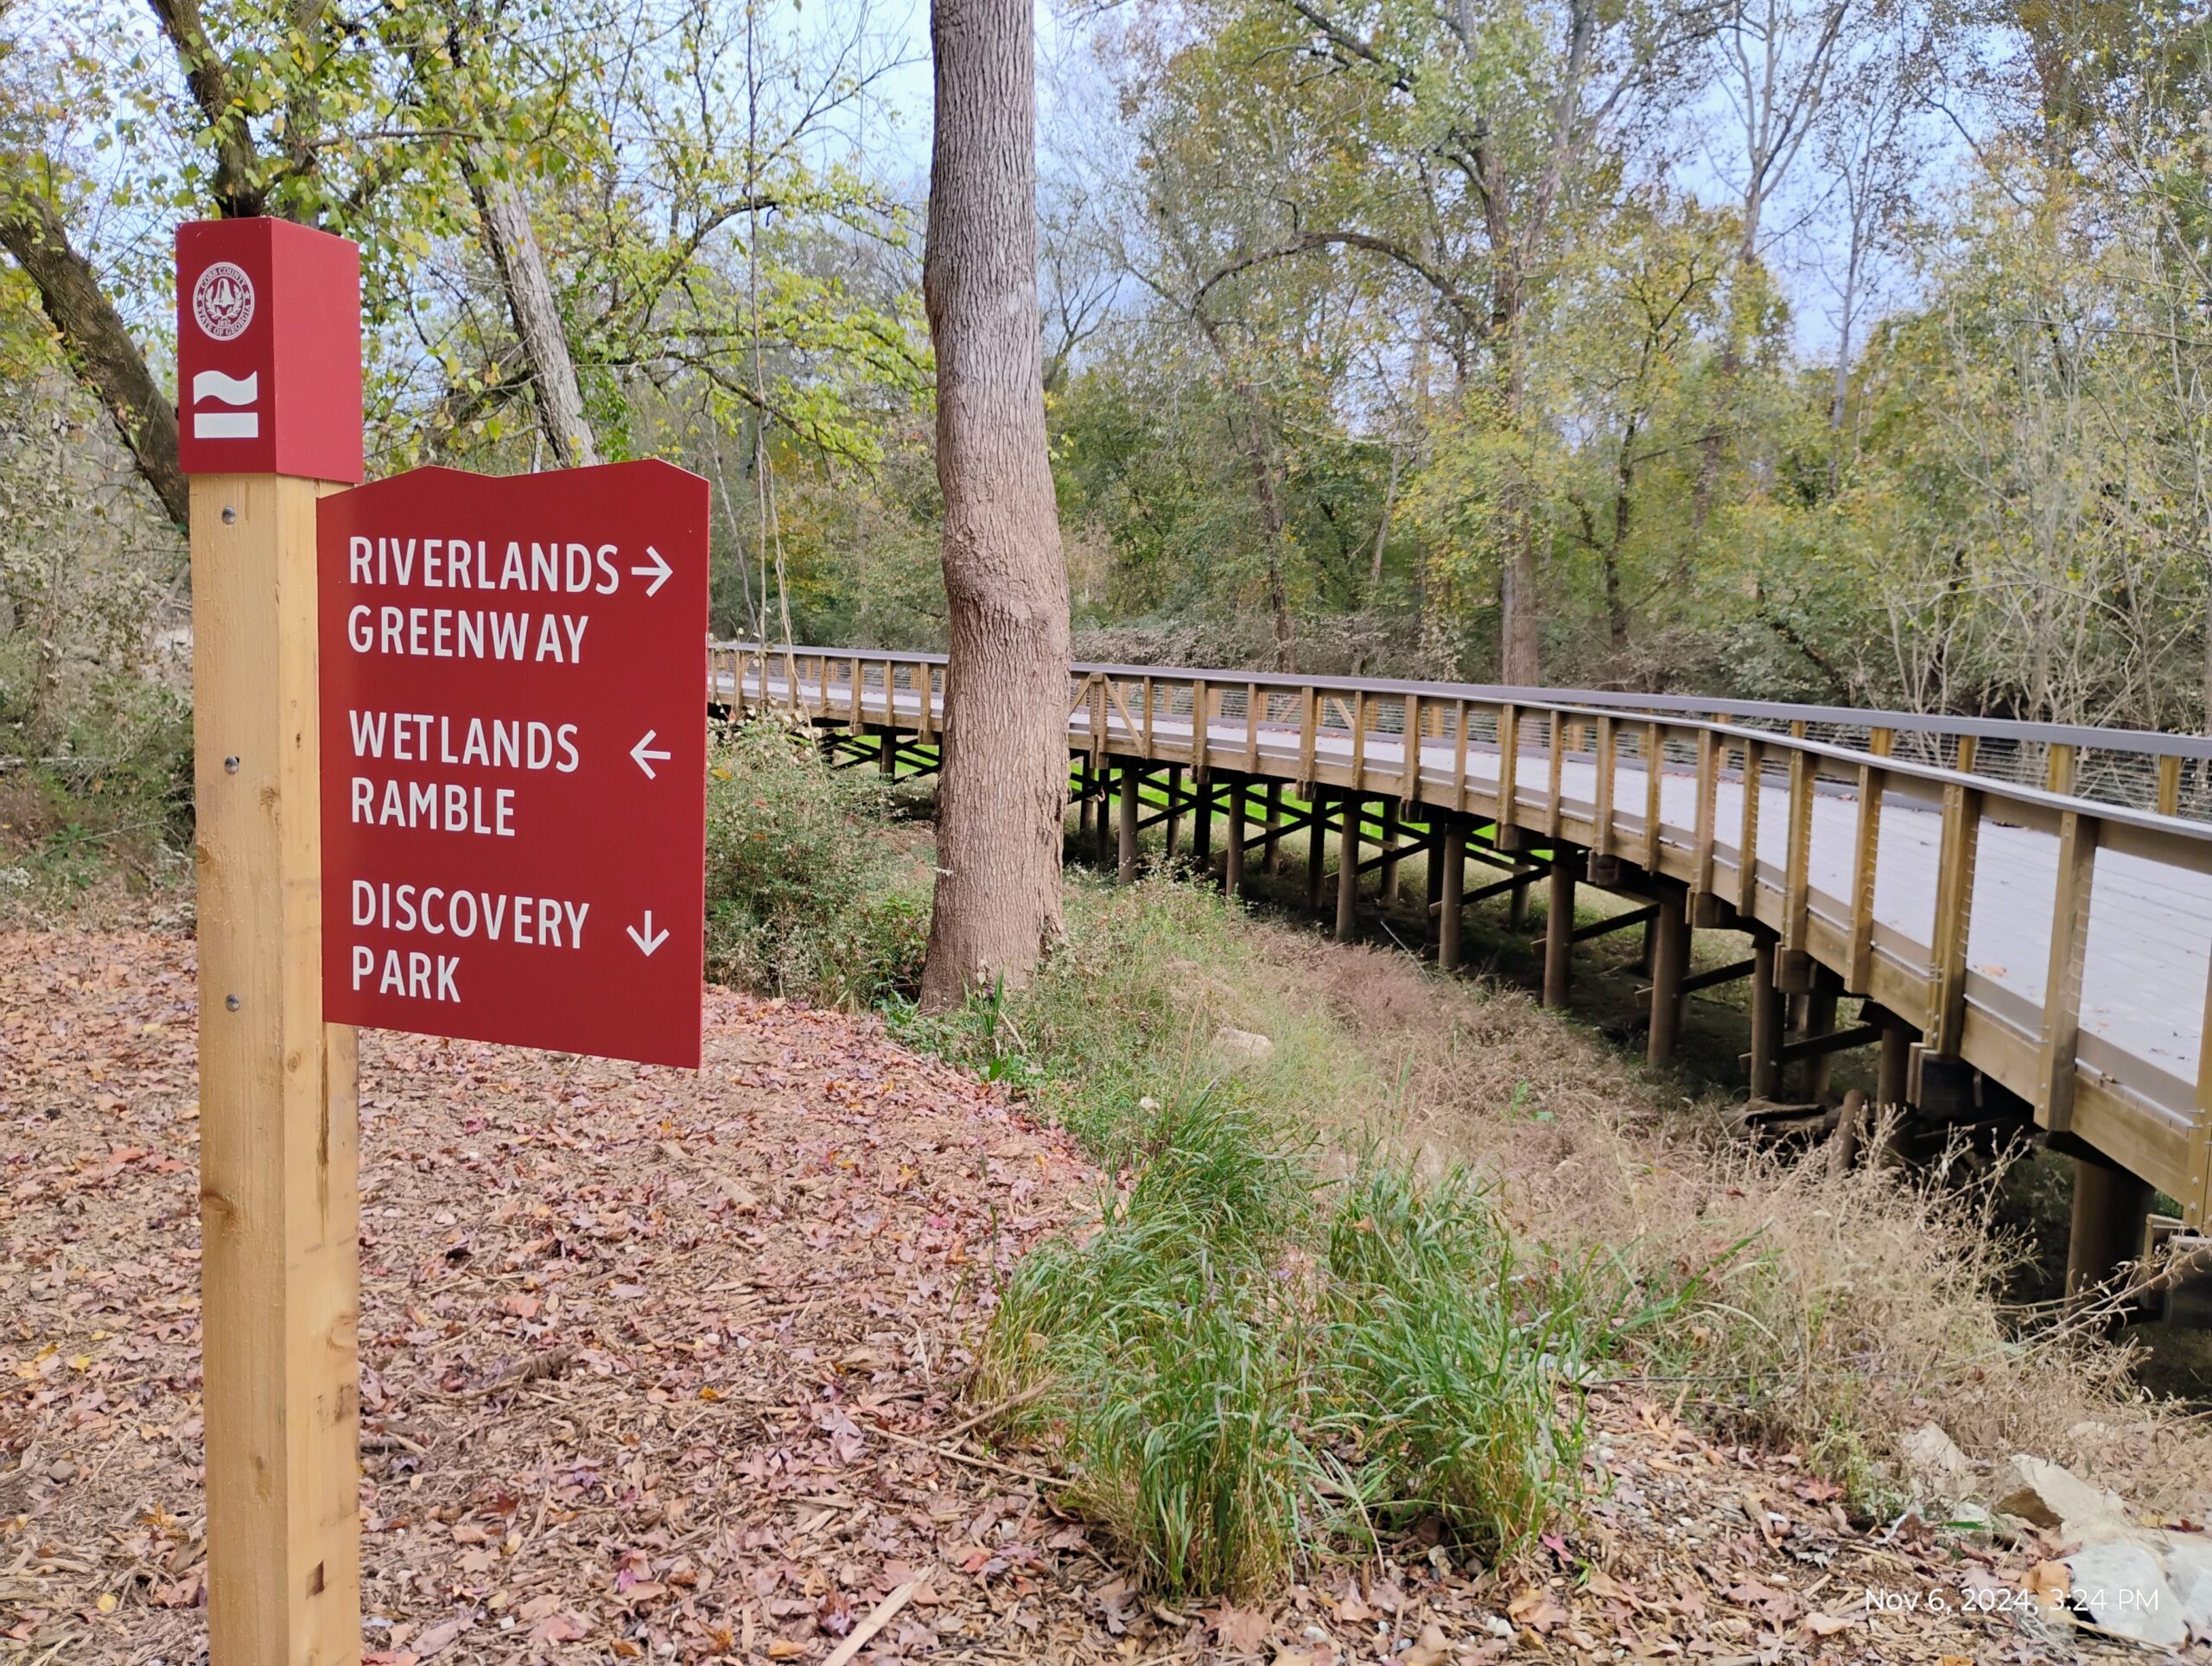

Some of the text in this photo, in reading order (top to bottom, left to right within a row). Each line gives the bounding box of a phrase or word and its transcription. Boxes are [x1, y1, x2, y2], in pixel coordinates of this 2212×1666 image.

[201, 267, 247, 289] COBB COUNTY
[198, 306, 212, 331] STATE
[226, 305, 251, 335] GEORGIA
[350, 537, 619, 594] RIVERLANDS
[348, 605, 588, 663] GREENWAY
[349, 710, 578, 773] WETLANDS
[353, 778, 514, 836] RAMBLE
[353, 881, 589, 949] DISCOVERY
[353, 946, 460, 1002] PARK
